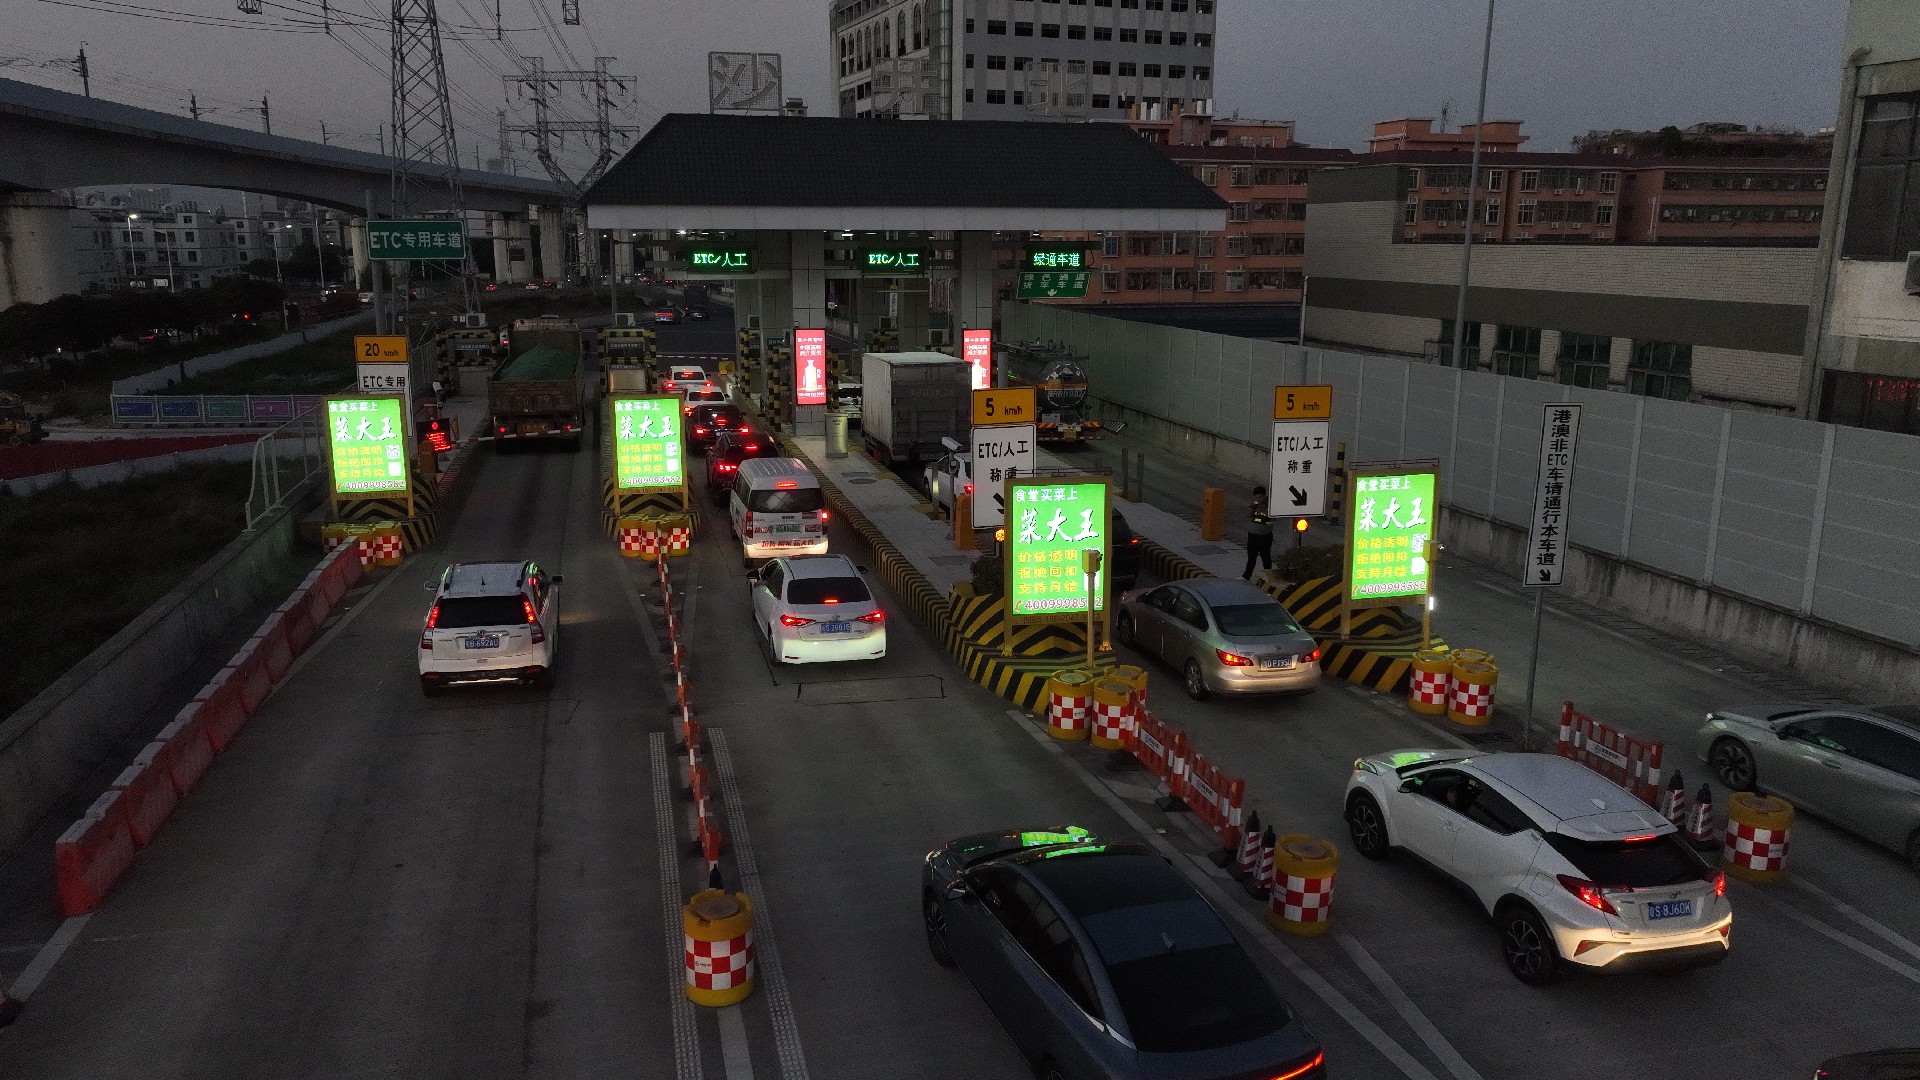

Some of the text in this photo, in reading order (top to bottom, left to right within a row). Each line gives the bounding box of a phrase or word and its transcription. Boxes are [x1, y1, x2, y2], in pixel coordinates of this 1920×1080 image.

[369, 231, 462, 249] ETC专用车道
[693, 253, 748, 266] ETC/人工
[868, 253, 919, 266] ETC/人工
[1033, 252, 1081, 267] 绿通车道
[364, 342, 400, 357] 20 km/h
[363, 376, 406, 388] ETC专用
[985, 397, 1023, 417] 5 km/h
[1286, 393, 1320, 411] 5 km/h
[334, 415, 398, 442] 菜大王
[619, 414, 677, 441] 菜大王
[978, 440, 1029, 459] ETC/人工
[1277, 436, 1324, 452] ETC/人工
[1287, 459, 1313, 474] 称重
[989, 466, 1018, 483] 称重
[1357, 477, 1411, 492] 食堂买菜上
[1536, 409, 1572, 566] 港澳非ETC车请通行本车道
[1015, 487, 1079, 502] 食堂买菜上
[1358, 496, 1427, 532] 菜大王
[1018, 507, 1099, 544] 菜大王
[1357, 535, 1409, 550] 价格透明
[1018, 549, 1078, 563] 价格透明
[1356, 552, 1407, 564] 拒绝回扣
[1018, 565, 1078, 578] 拒绝回扣
[1356, 565, 1406, 579] 支持月结
[1018, 581, 1078, 595] 支持月结
[1361, 581, 1427, 594] 4009998582
[1025, 596, 1102, 610] 400999852
